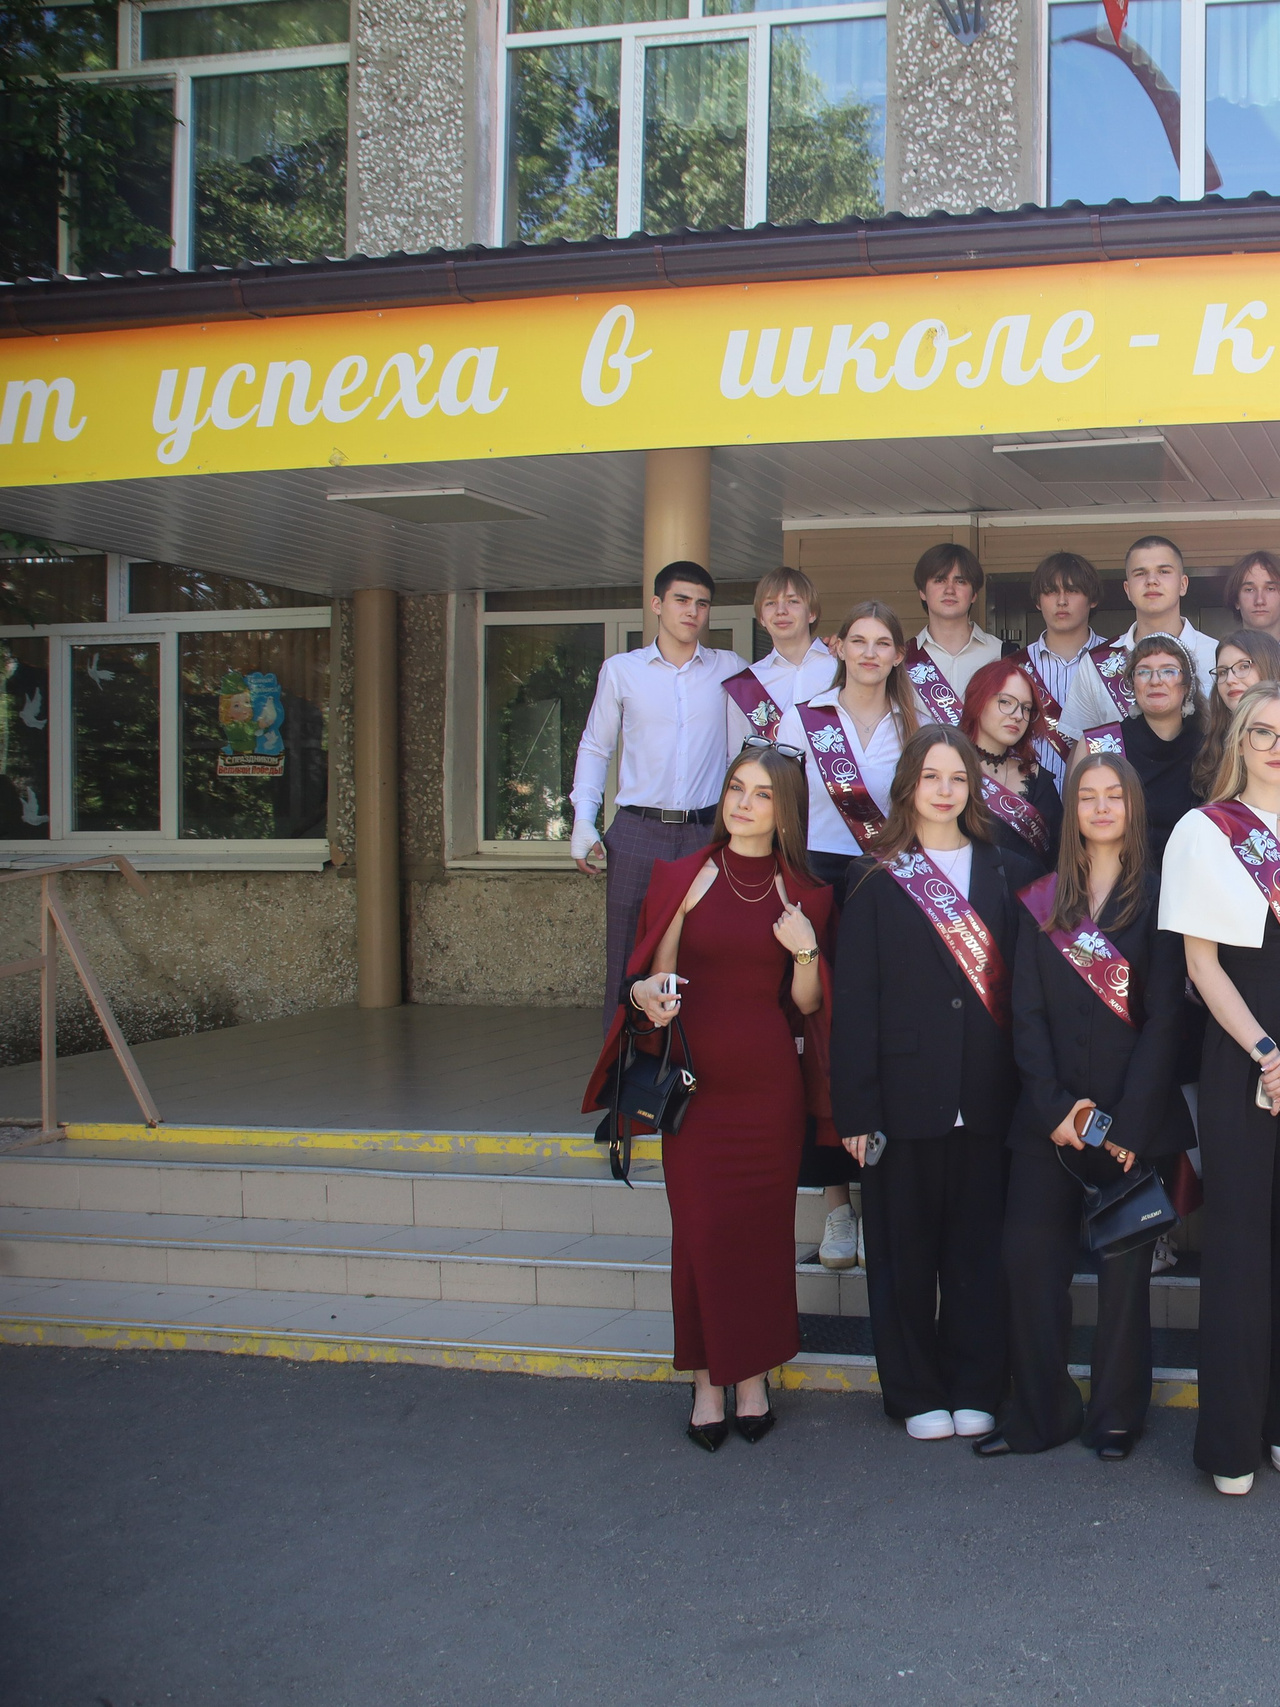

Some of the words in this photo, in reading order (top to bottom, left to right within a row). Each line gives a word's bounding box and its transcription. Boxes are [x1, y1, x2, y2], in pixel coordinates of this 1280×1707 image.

[0, 374, 86, 445] т
[153, 343, 508, 465] успеха
[581, 304, 653, 406] в
[719, 309, 1100, 399] школе
[1129, 334, 1159, 348] -
[1192, 300, 1275, 376] к
